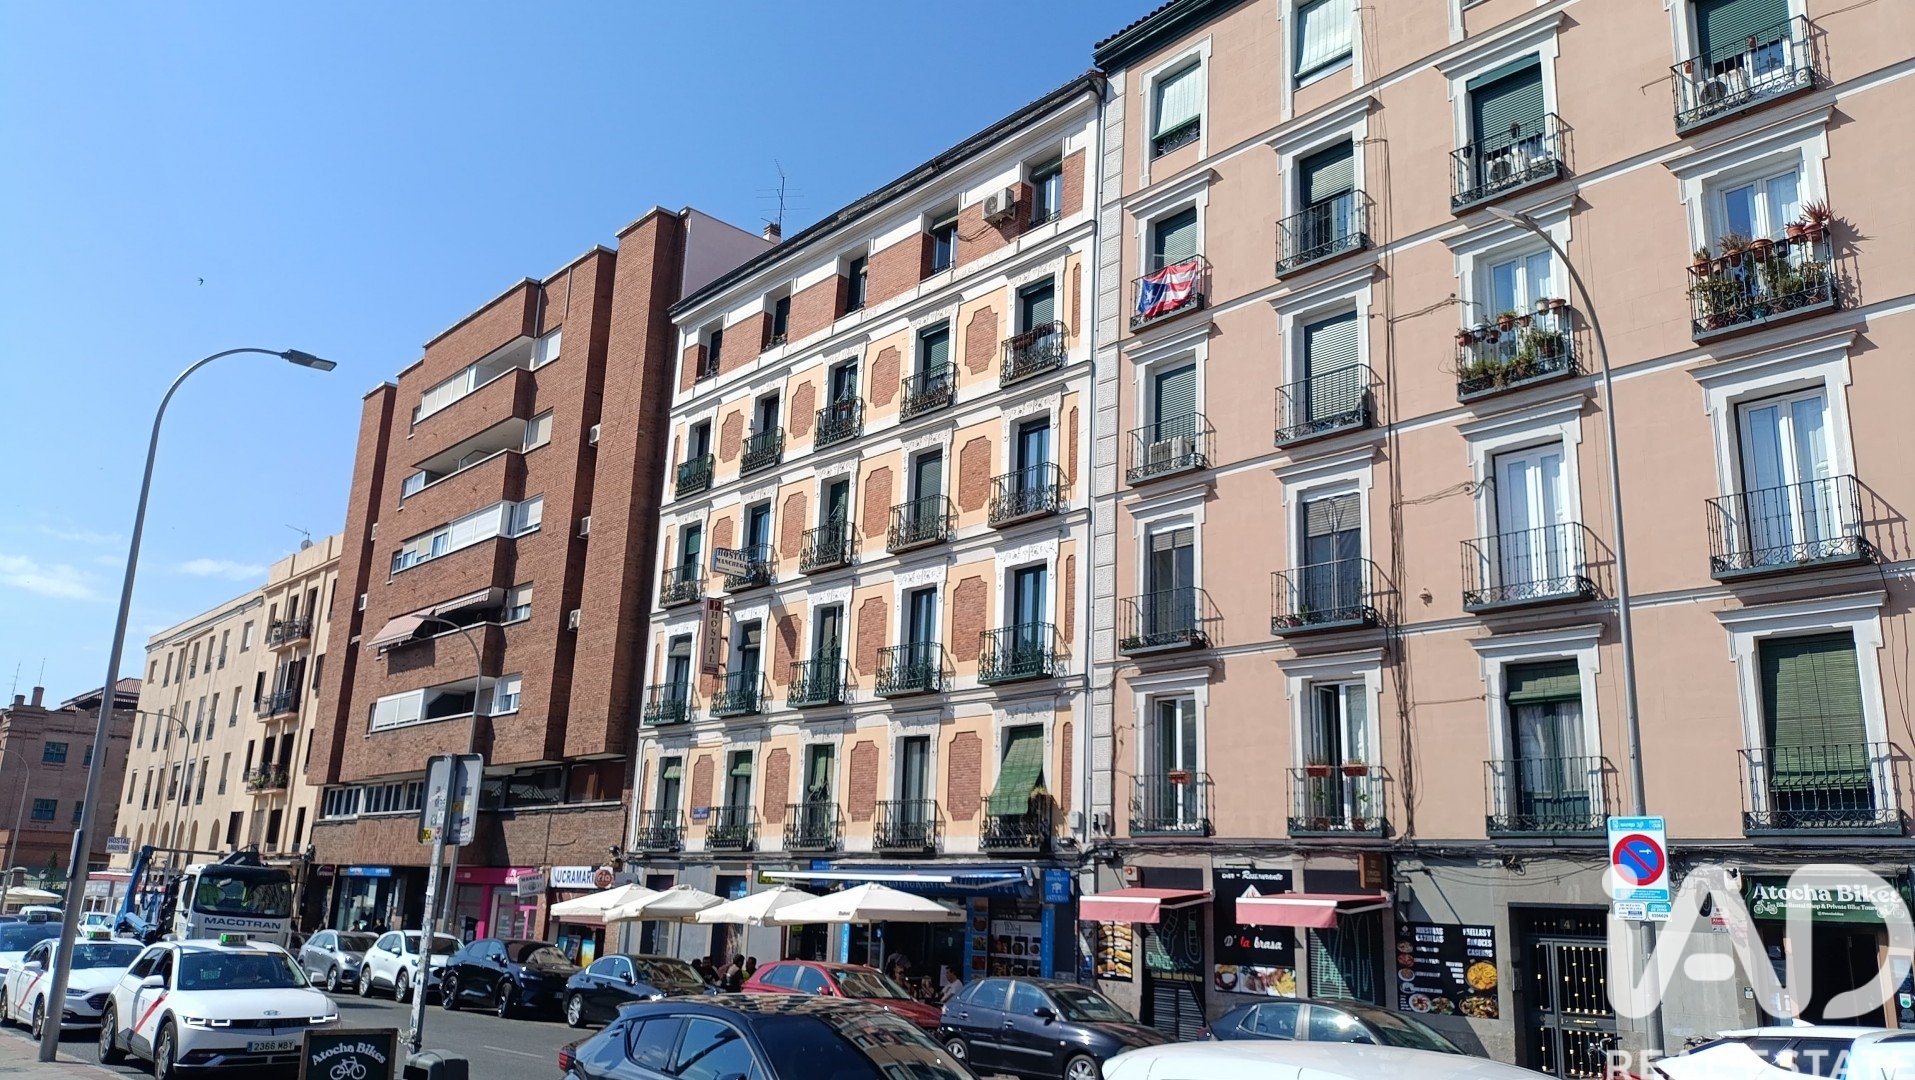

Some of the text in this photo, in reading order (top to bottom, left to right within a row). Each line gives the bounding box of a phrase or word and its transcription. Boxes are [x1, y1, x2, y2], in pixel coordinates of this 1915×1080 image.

[717, 549, 746, 562] HOSTAL
[709, 611, 718, 663] HOSTAL
[1753, 883, 1903, 903] Atocha Bikes
[204, 917, 281, 929] MACOTRAN
[1240, 936, 1251, 947] la
[1254, 936, 1283, 950] brasa
[254, 1042, 276, 1051] 2366
[311, 1042, 386, 1066] Atocha Bikes
